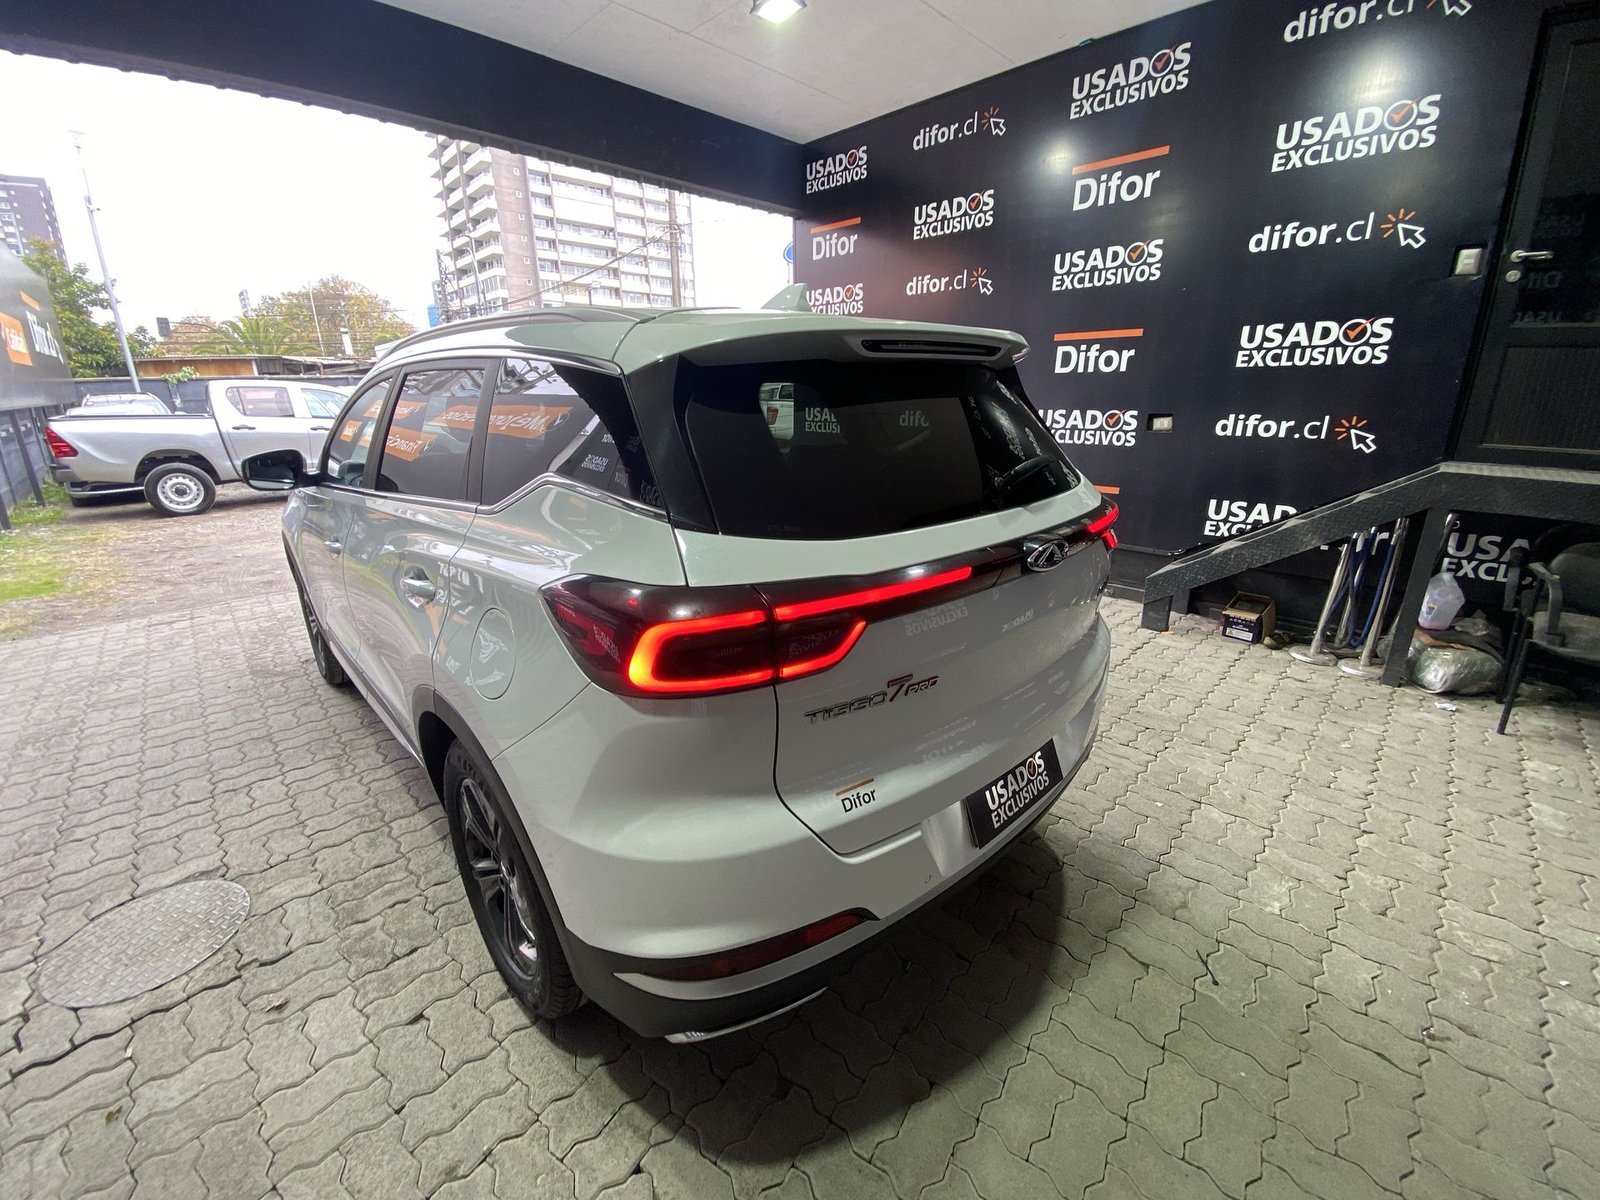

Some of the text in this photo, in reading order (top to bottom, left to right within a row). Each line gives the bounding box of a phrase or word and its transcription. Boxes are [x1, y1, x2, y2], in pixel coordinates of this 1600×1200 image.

[1072, 42, 1192, 100] USADOS
[1069, 70, 1190, 120] EXCLUSIVOS
[913, 112, 978, 151] difor.cl
[1276, 94, 1442, 150] USADOS
[807, 145, 868, 181] USADOS
[1271, 125, 1438, 173] EXCLUSIVOS
[806, 169, 868, 194] EXCLUSIVOS
[1072, 169, 1161, 212] Difor
[914, 189, 995, 226] USADOS
[913, 212, 994, 240] EXCLUSIVOS
[1248, 212, 1375, 253] difor.cl
[812, 232, 858, 261] Difor
[1054, 239, 1164, 274] USADOS
[906, 270, 967, 296] difor.cl
[1052, 263, 1161, 292] EXCLUSIVOS
[805, 283, 863, 306] USADOS
[811, 300, 863, 316] XCLUSIVOS
[1240, 316, 1395, 349] USADOS
[1054, 344, 1135, 374] Difor
[1235, 345, 1389, 368] EXCLUSIVOS
[1038, 409, 1139, 431] USADOS
[1215, 414, 1330, 440] difor.cl
[1051, 429, 1136, 447] CLUSIVOS
[1208, 499, 1297, 524] USAD
[1447, 533, 1530, 562] USA
[803, 690, 888, 724] TIGGO
[985, 751, 1044, 811] USADOS
[841, 788, 877, 813] Difor
[991, 772, 1050, 830] EXCLUSIVOS
